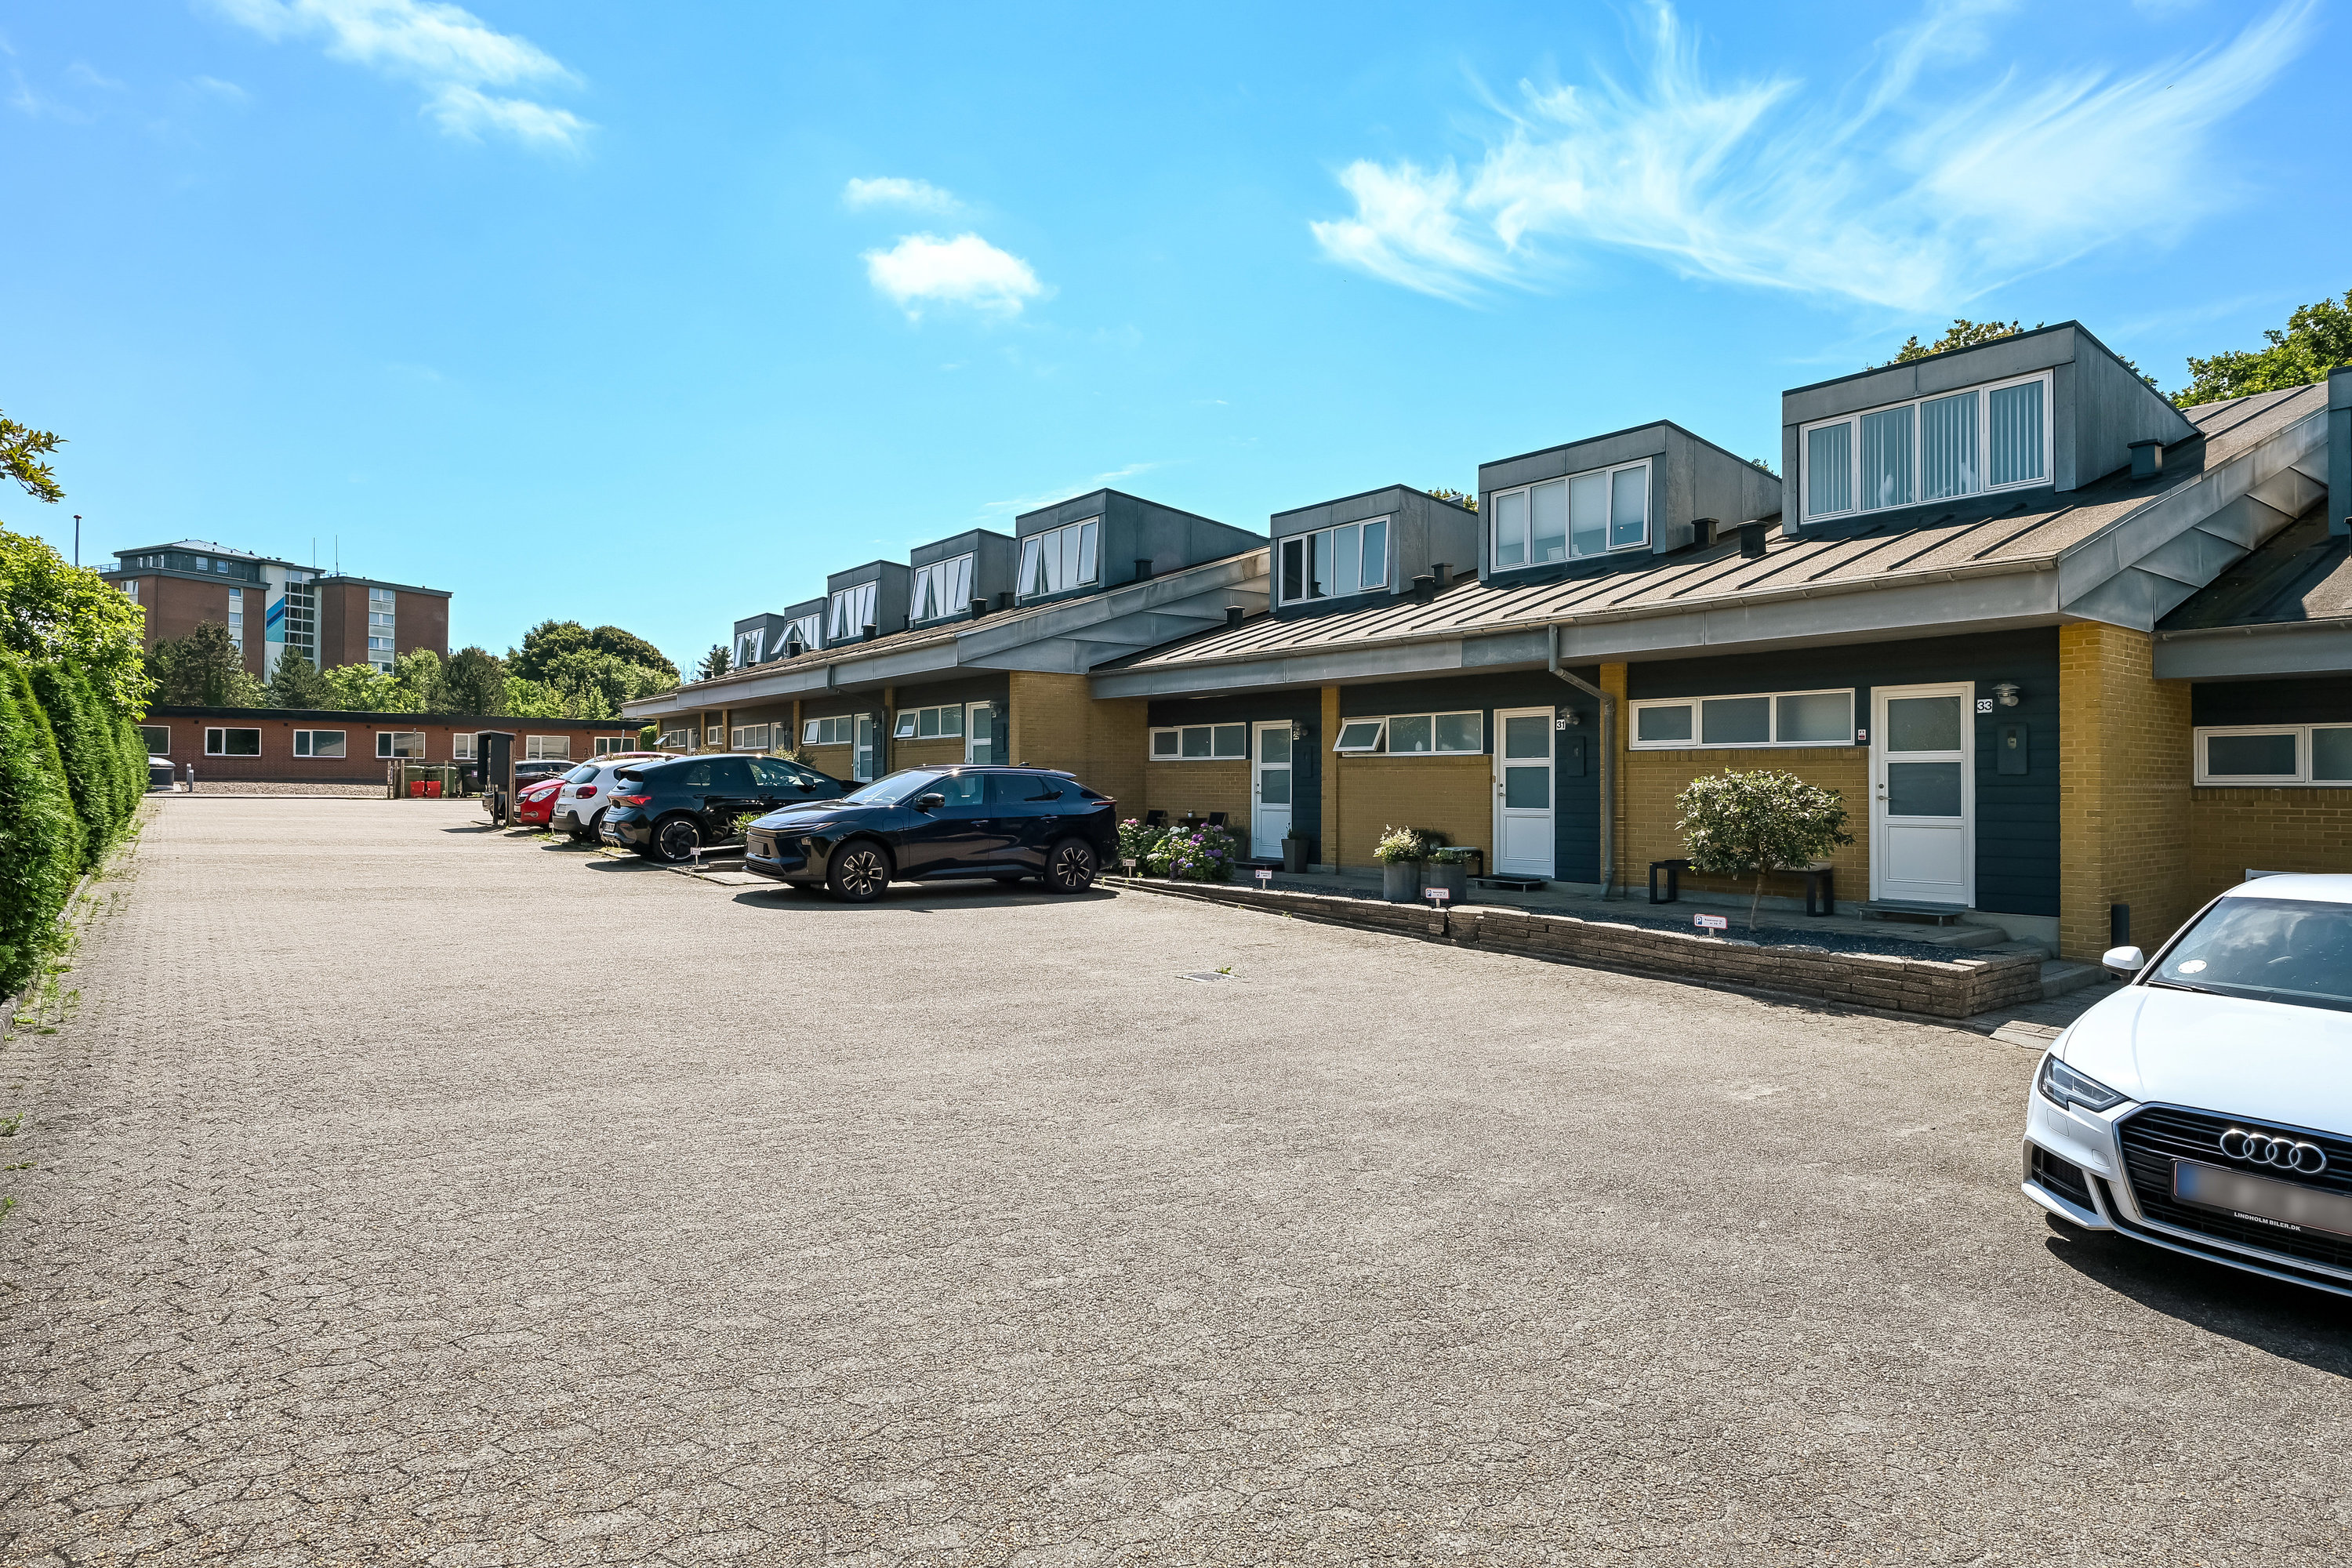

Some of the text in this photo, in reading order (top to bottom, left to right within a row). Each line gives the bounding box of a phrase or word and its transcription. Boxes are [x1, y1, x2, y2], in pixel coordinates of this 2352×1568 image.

[1977, 701, 1992, 711] 33
[1556, 720, 1565, 729] 31
[2234, 1211, 2301, 1232] LINDHOLM BILER.DK
